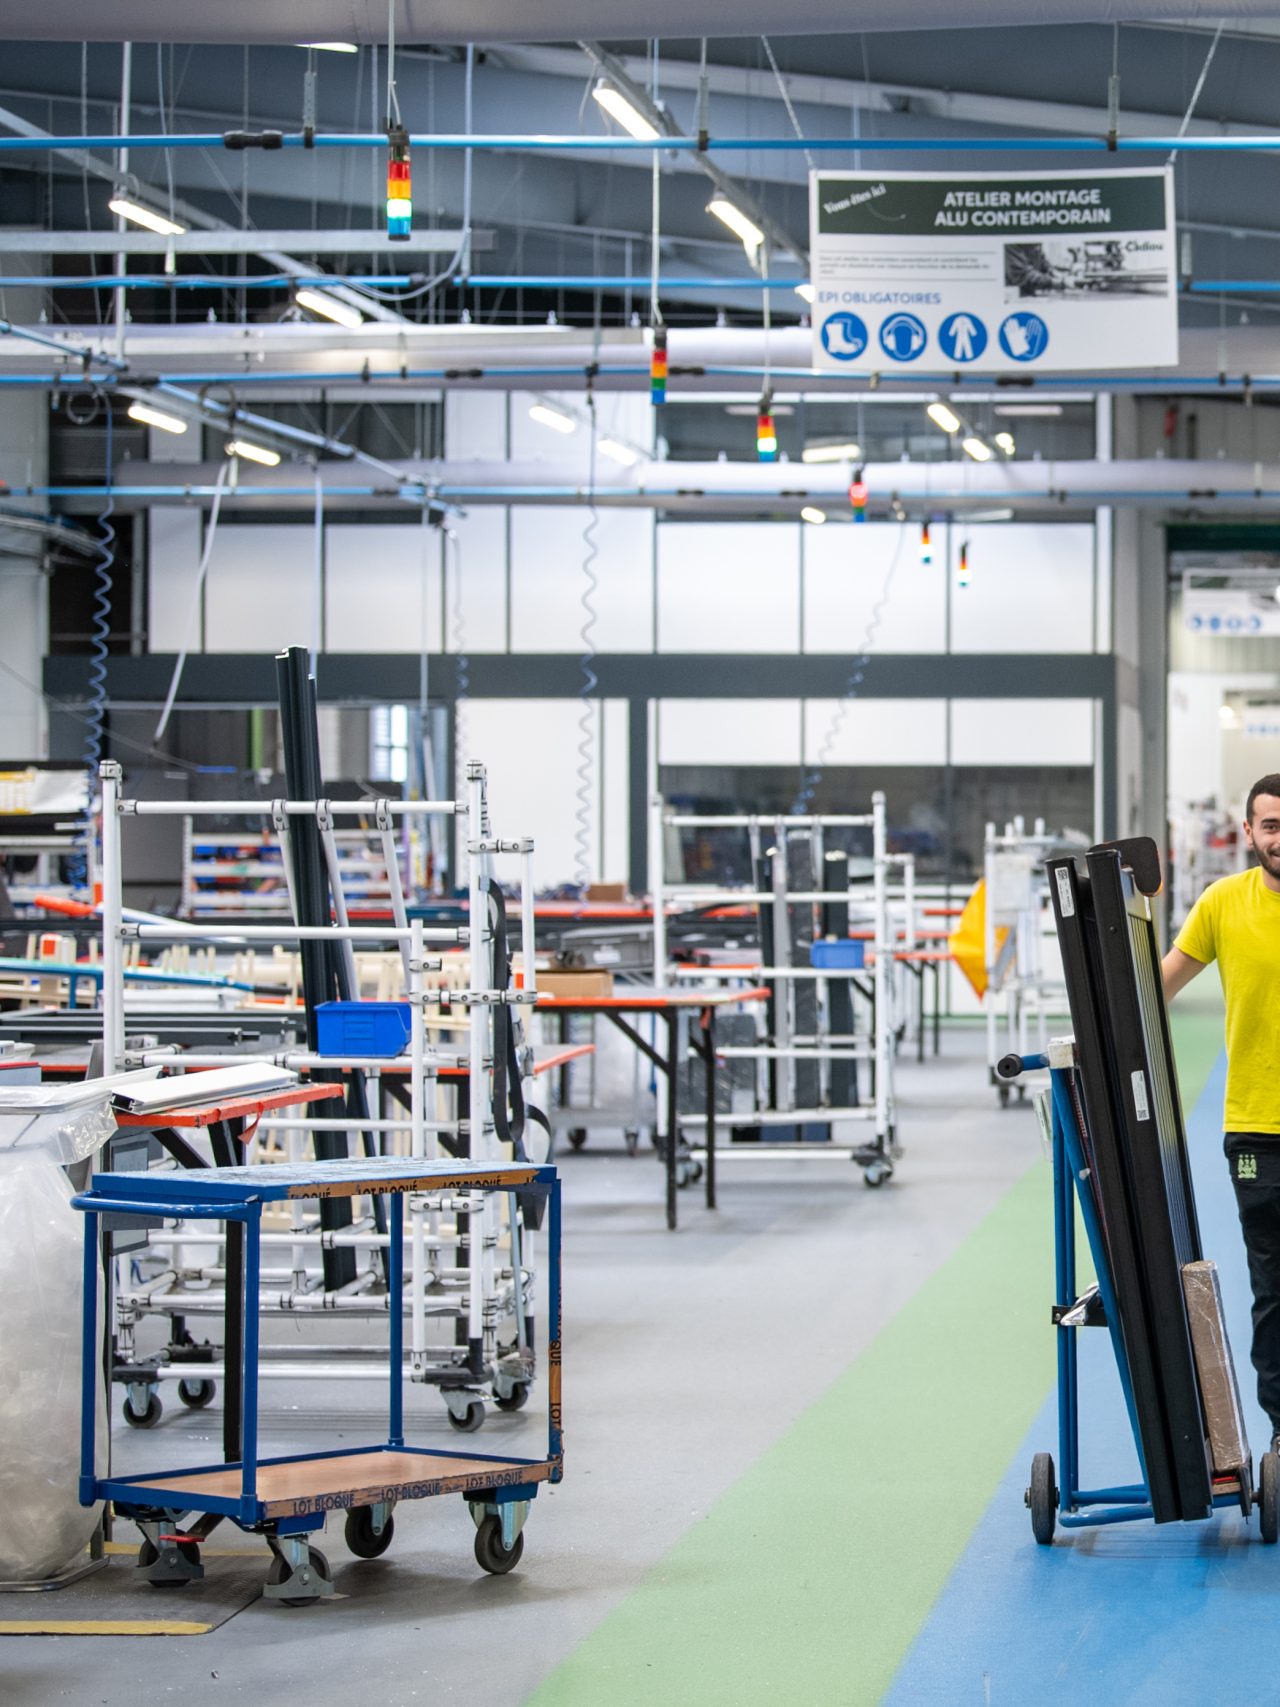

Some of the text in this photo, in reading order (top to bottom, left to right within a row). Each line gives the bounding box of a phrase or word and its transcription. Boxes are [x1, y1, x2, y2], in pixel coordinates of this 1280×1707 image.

[944, 189, 1101, 207] ATELIER MONTAGE
[934, 208, 1111, 226] ALU CONTEMPORAIN
[818, 291, 941, 304] EPI OBLIGATOIRES
[294, 1500, 312, 1514] LOT
